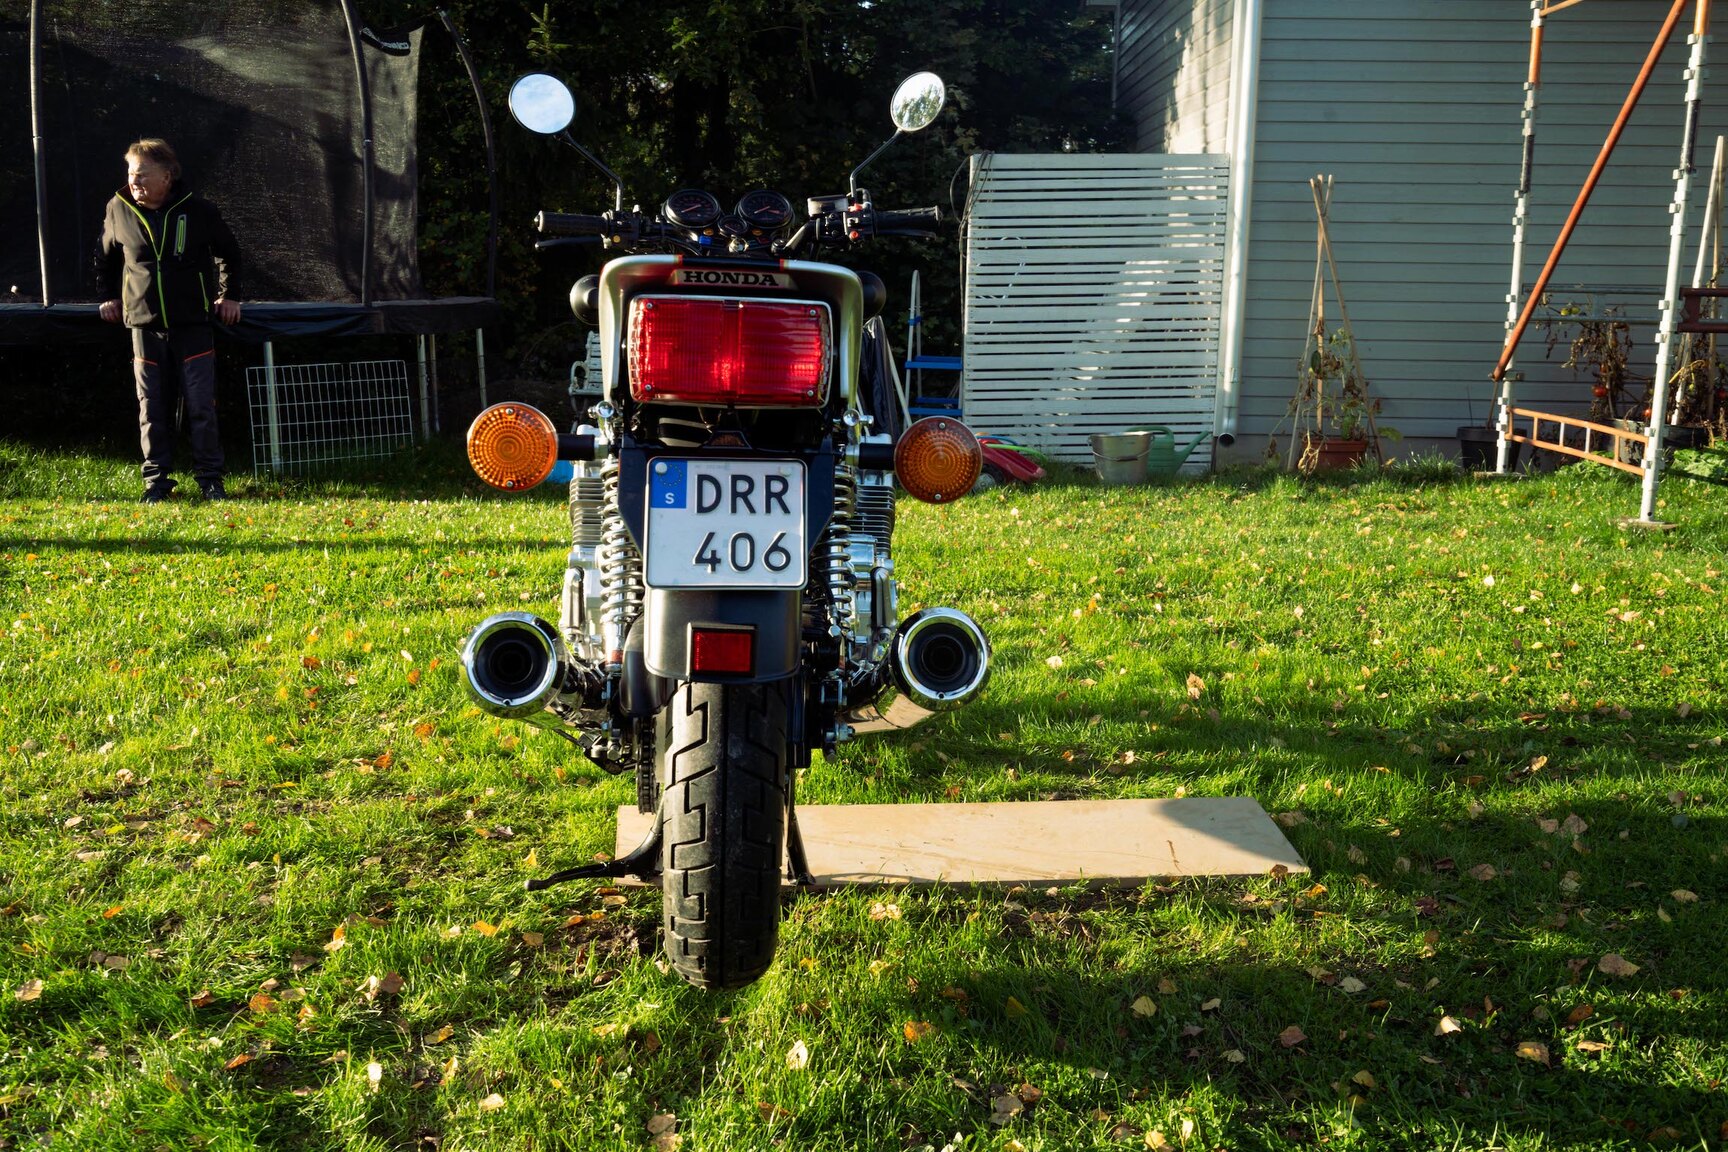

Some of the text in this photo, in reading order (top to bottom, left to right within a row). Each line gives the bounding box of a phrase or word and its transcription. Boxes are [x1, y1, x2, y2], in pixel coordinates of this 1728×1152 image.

[683, 271, 779, 287] HONDA
[665, 492, 675, 504] S
[696, 474, 791, 514] DRR
[694, 531, 791, 573] 406
